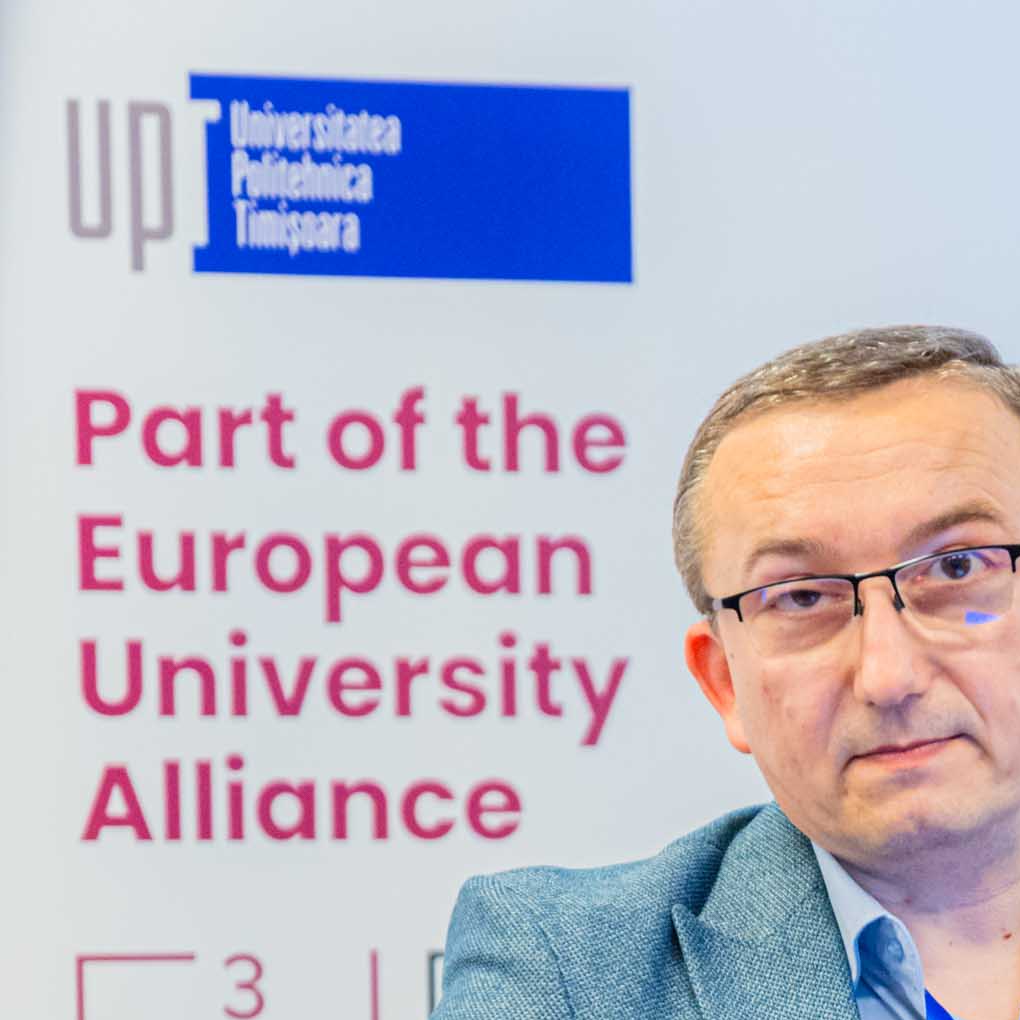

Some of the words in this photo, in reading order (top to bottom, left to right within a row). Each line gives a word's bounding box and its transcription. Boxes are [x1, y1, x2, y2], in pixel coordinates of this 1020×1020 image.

[229, 99, 402, 154] Universitatea
[231, 149, 374, 203] Politehnica
[73, 388, 296, 470] Part
[324, 385, 428, 472] of
[455, 391, 629, 475] the
[77, 513, 594, 624] European
[79, 628, 631, 748] University
[80, 752, 523, 842] Alliance
